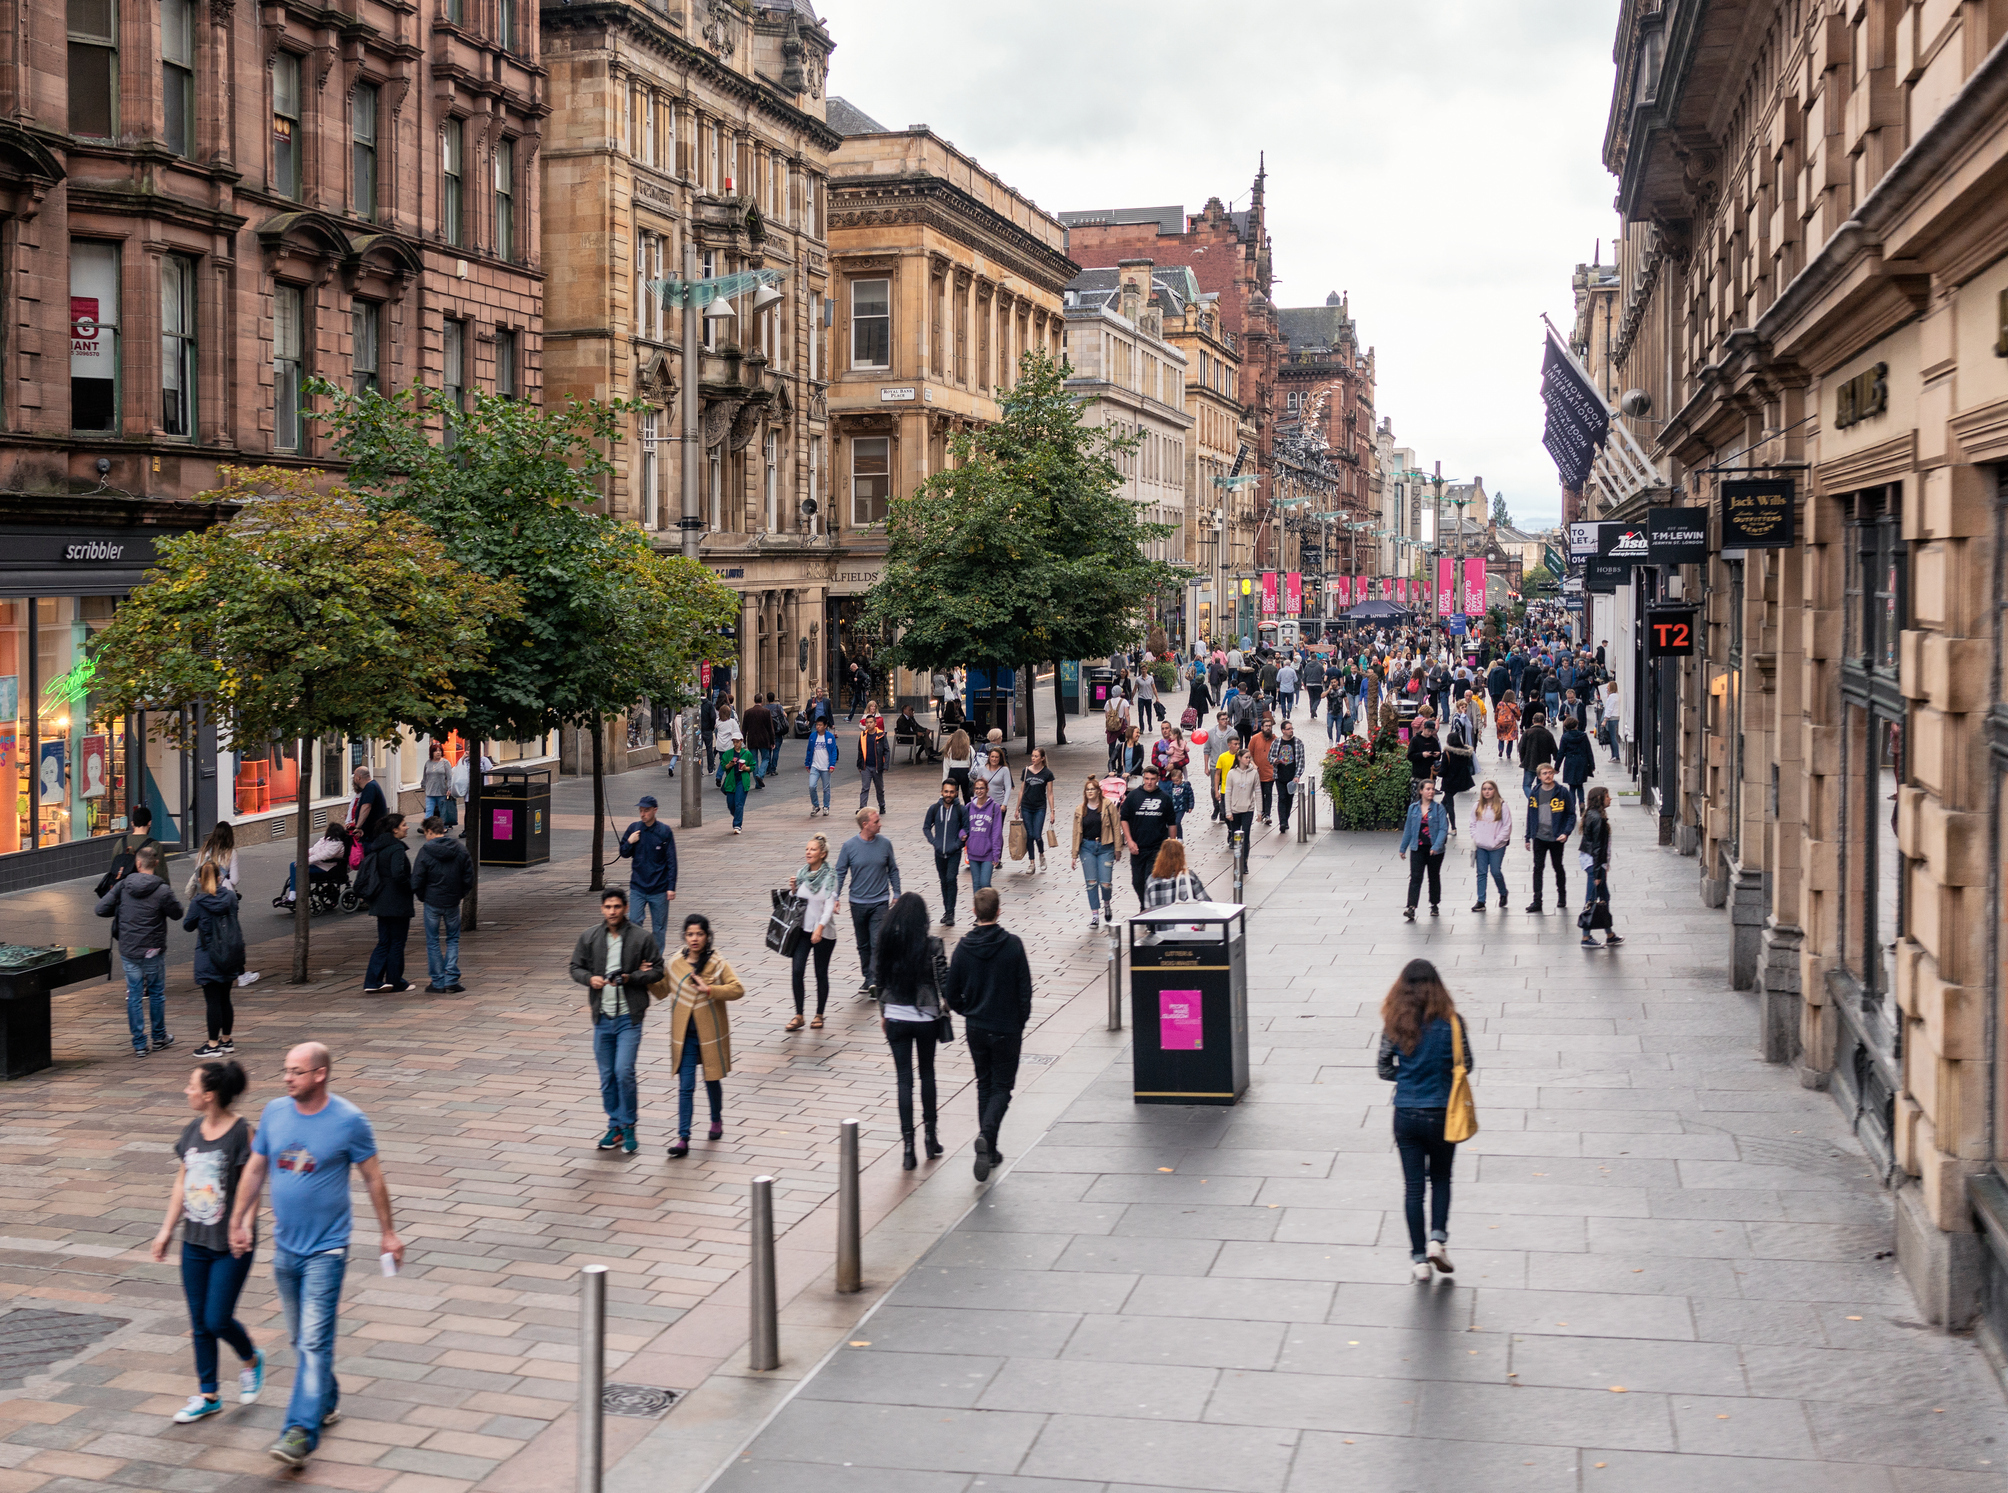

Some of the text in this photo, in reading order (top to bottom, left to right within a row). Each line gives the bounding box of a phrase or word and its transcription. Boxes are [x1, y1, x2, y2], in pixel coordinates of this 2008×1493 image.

[77, 316, 95, 336] G
[1545, 369, 1596, 432] INTERNATIONAL
[1551, 363, 1603, 428] RAINBOW ROOM
[1569, 423, 1588, 448] ROOM
[1412, 485, 1421, 526] ENOCH
[1729, 494, 1787, 510] Jack Wills
[66, 541, 124, 560] scribbler
[1571, 537, 1588, 545] LET
[1653, 623, 1689, 647] T2
